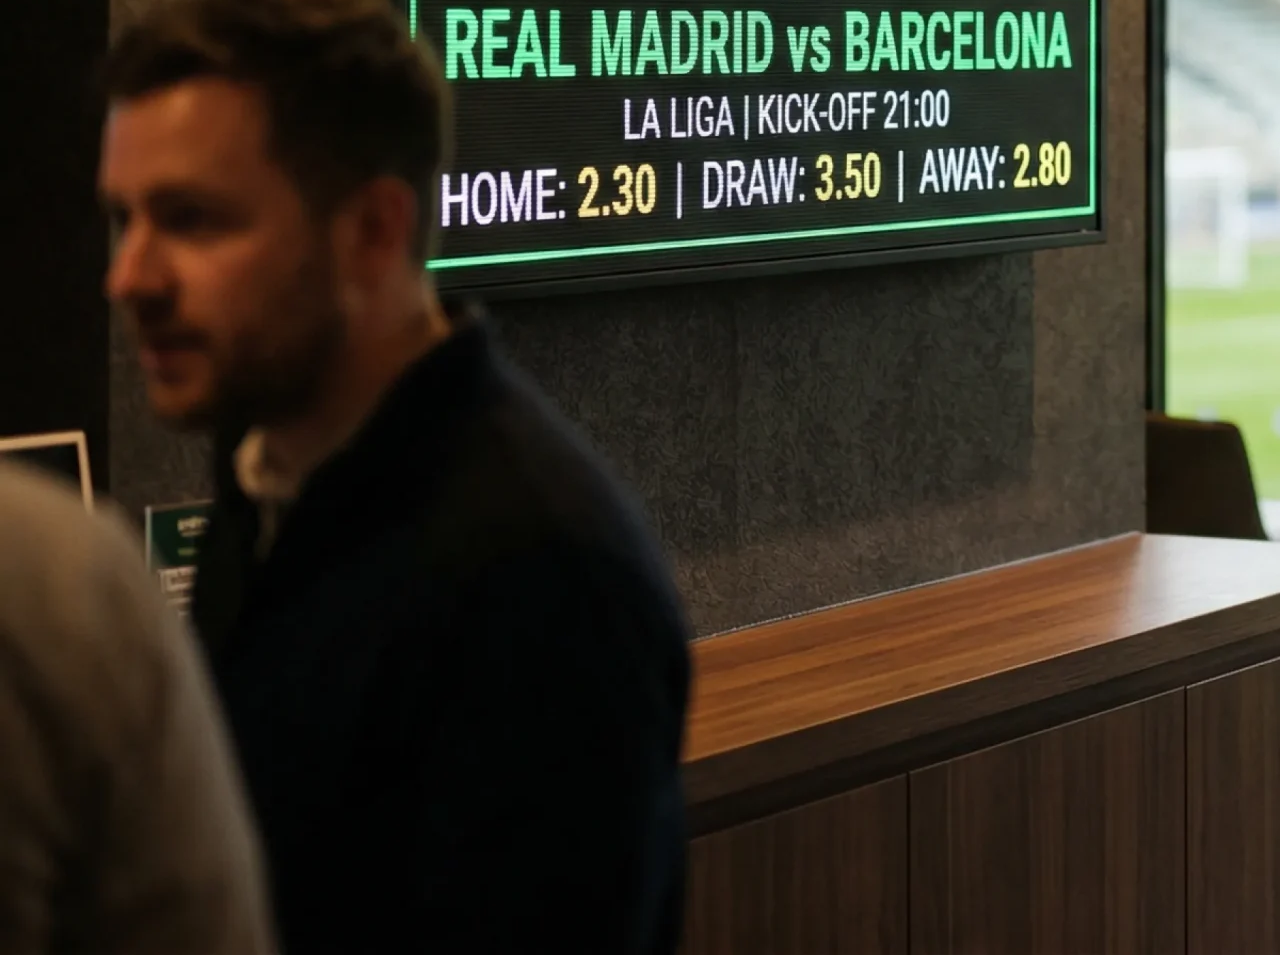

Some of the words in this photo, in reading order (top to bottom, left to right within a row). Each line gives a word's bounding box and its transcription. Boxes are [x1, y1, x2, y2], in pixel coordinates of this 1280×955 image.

[445, 8, 577, 80] REAL
[591, 9, 774, 77] MADRID
[786, 25, 831, 73] vs
[845, 10, 1073, 72] BARCELONA
[624, 98, 661, 140] LA
[670, 95, 735, 138] LIGA
[758, 91, 878, 135] KICK-OFF
[883, 88, 950, 129] 21:00
[441, 168, 566, 227] HOME:
[577, 163, 656, 218] 2.30
[702, 156, 806, 209] DRAW:
[814, 151, 882, 202] 3.50
[918, 145, 1006, 194] AWAY:
[1013, 140, 1072, 188] 2.80
